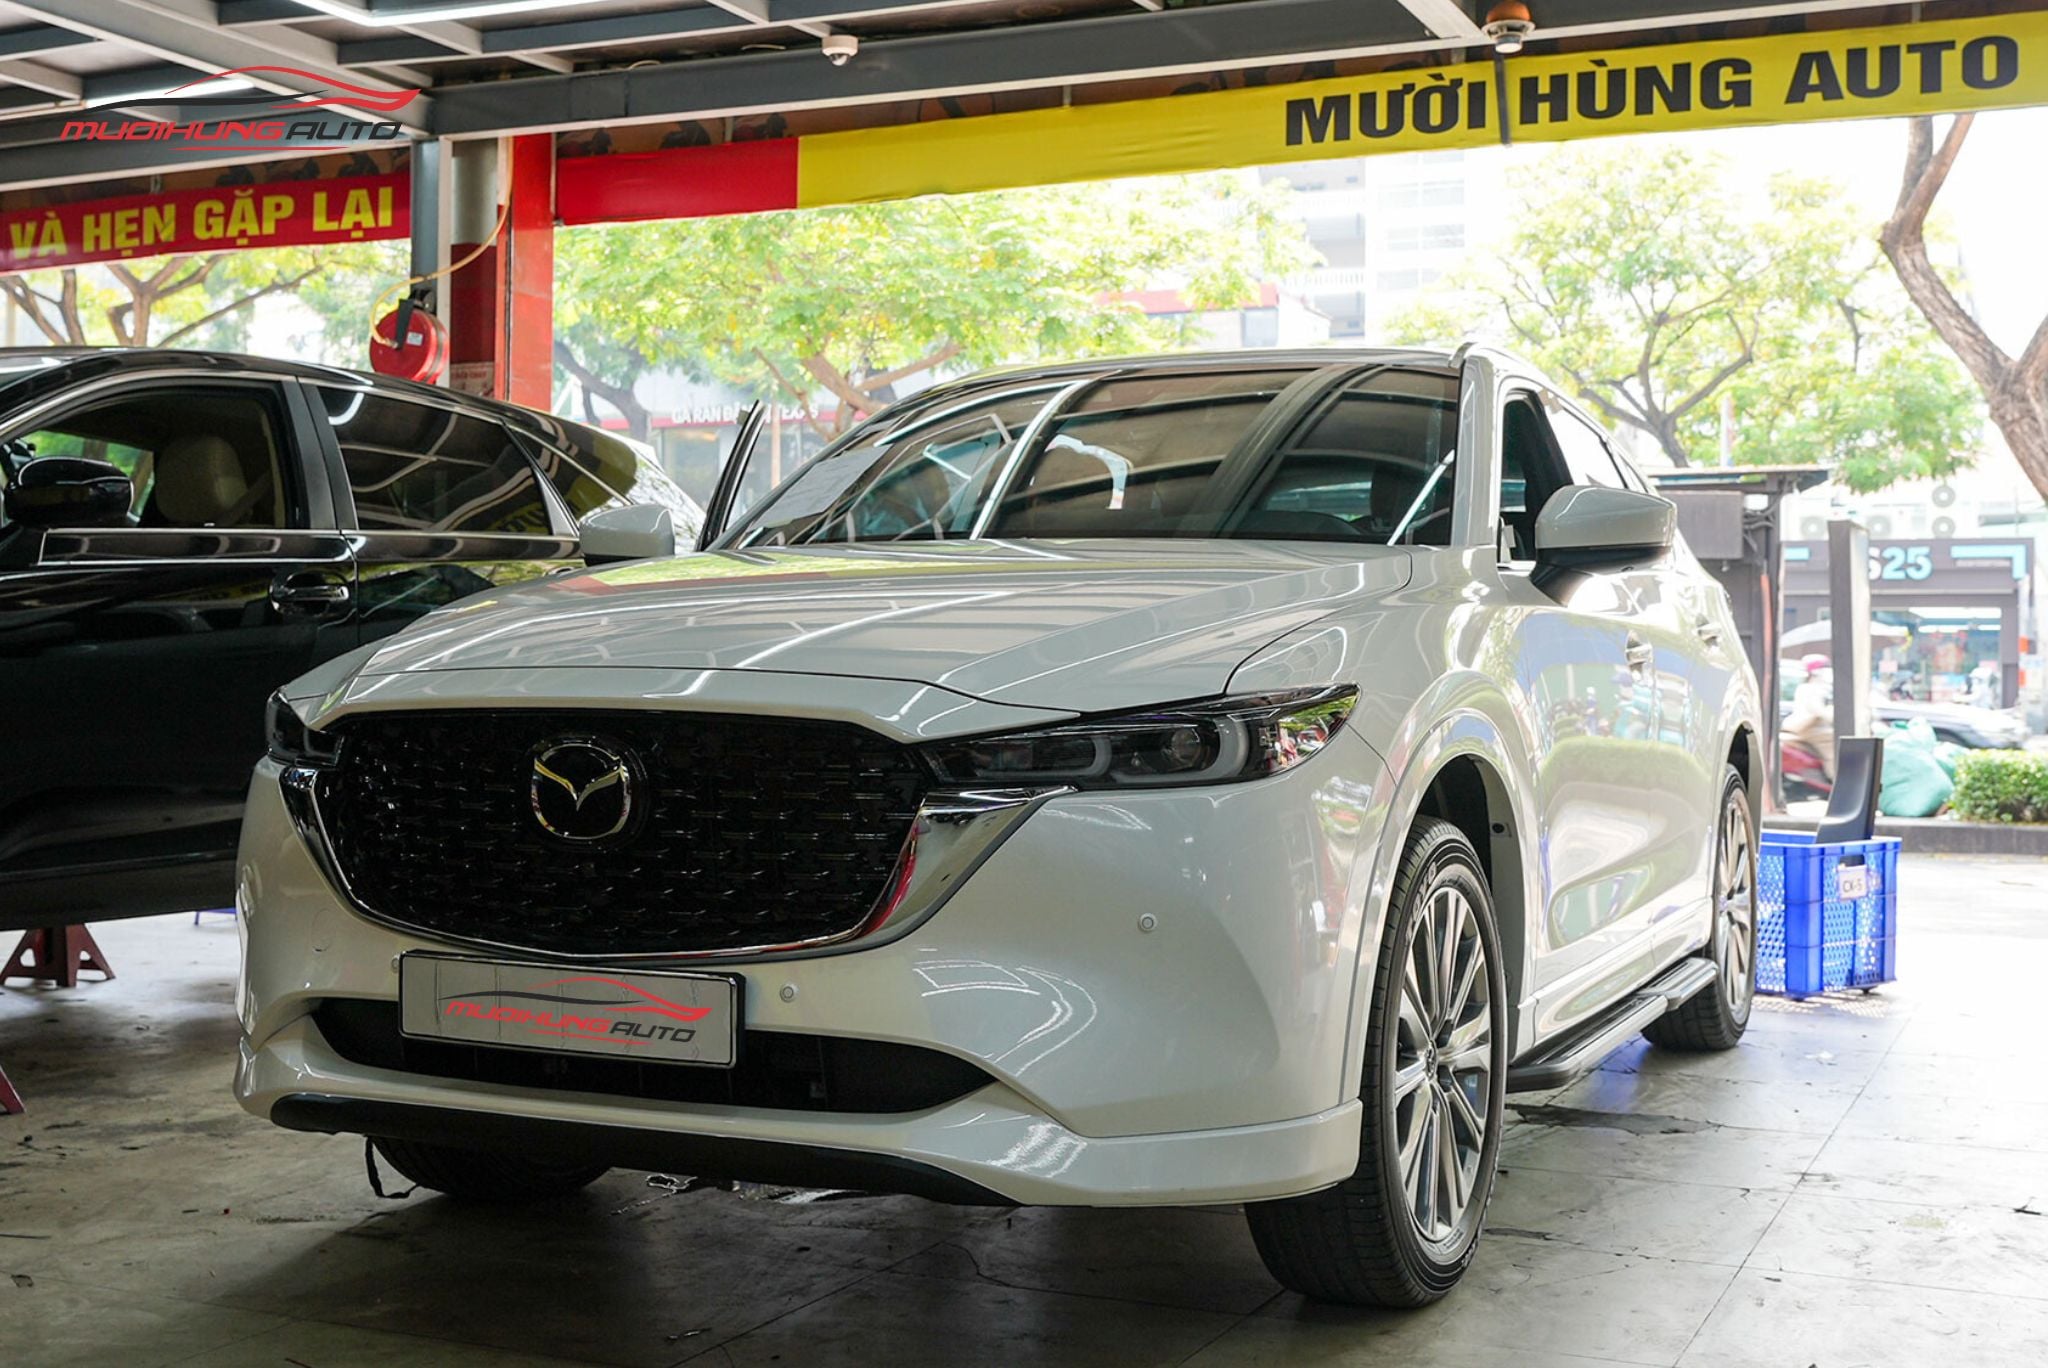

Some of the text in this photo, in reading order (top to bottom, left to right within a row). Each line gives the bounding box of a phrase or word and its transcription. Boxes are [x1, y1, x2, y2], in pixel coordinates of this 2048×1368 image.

[1285, 36, 2019, 146] MƯỜI HÙNG AUTO
[10, 187, 393, 259] VÀ HẸN GẶP LẠI
